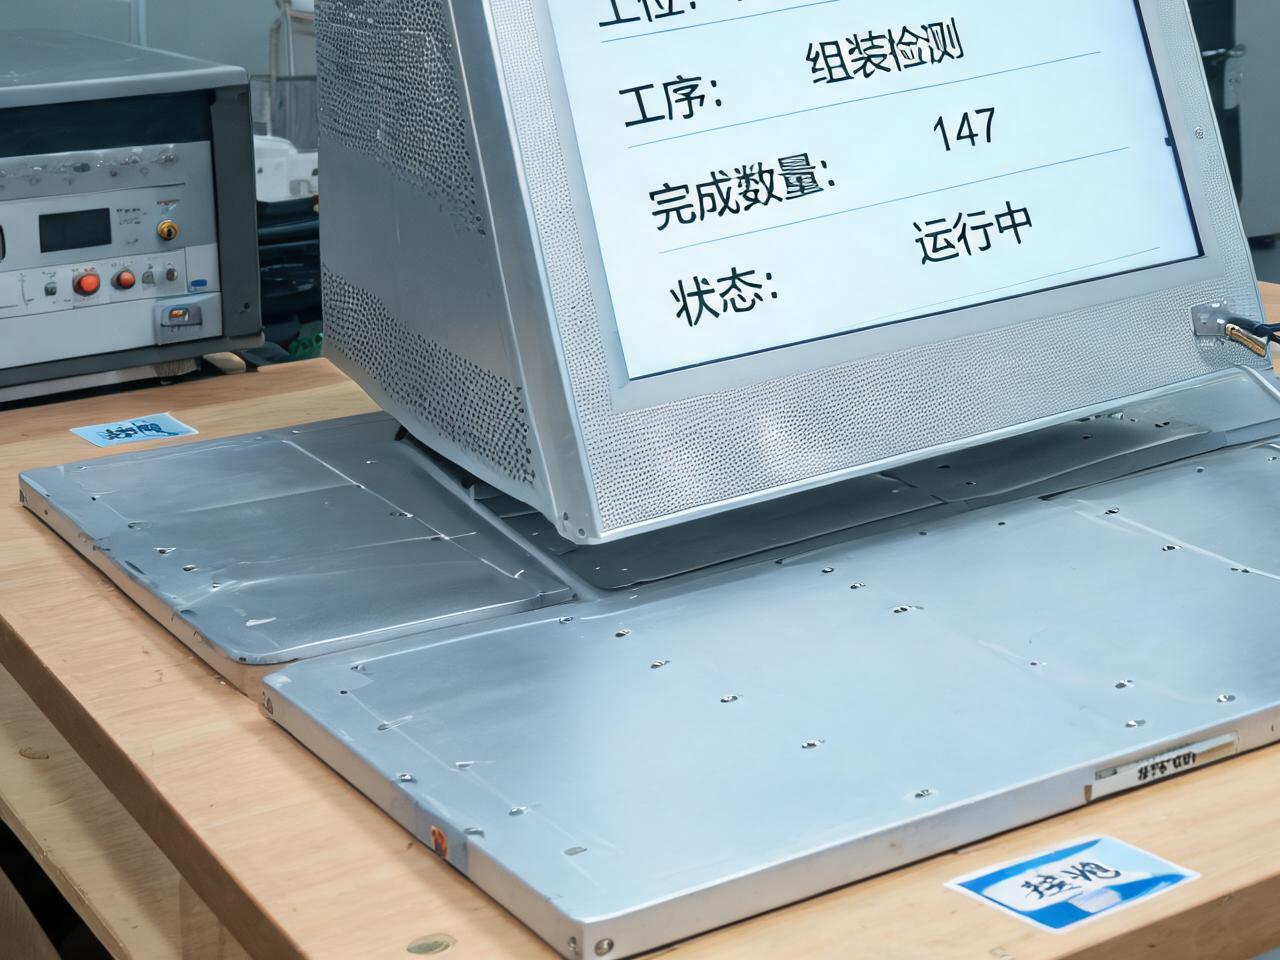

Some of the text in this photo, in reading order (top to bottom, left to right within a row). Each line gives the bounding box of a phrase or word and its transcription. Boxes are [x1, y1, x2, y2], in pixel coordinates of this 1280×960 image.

[805, 17, 964, 84] 组装检测
[933, 107, 995, 152] 147
[912, 200, 1033, 265] 运行中
